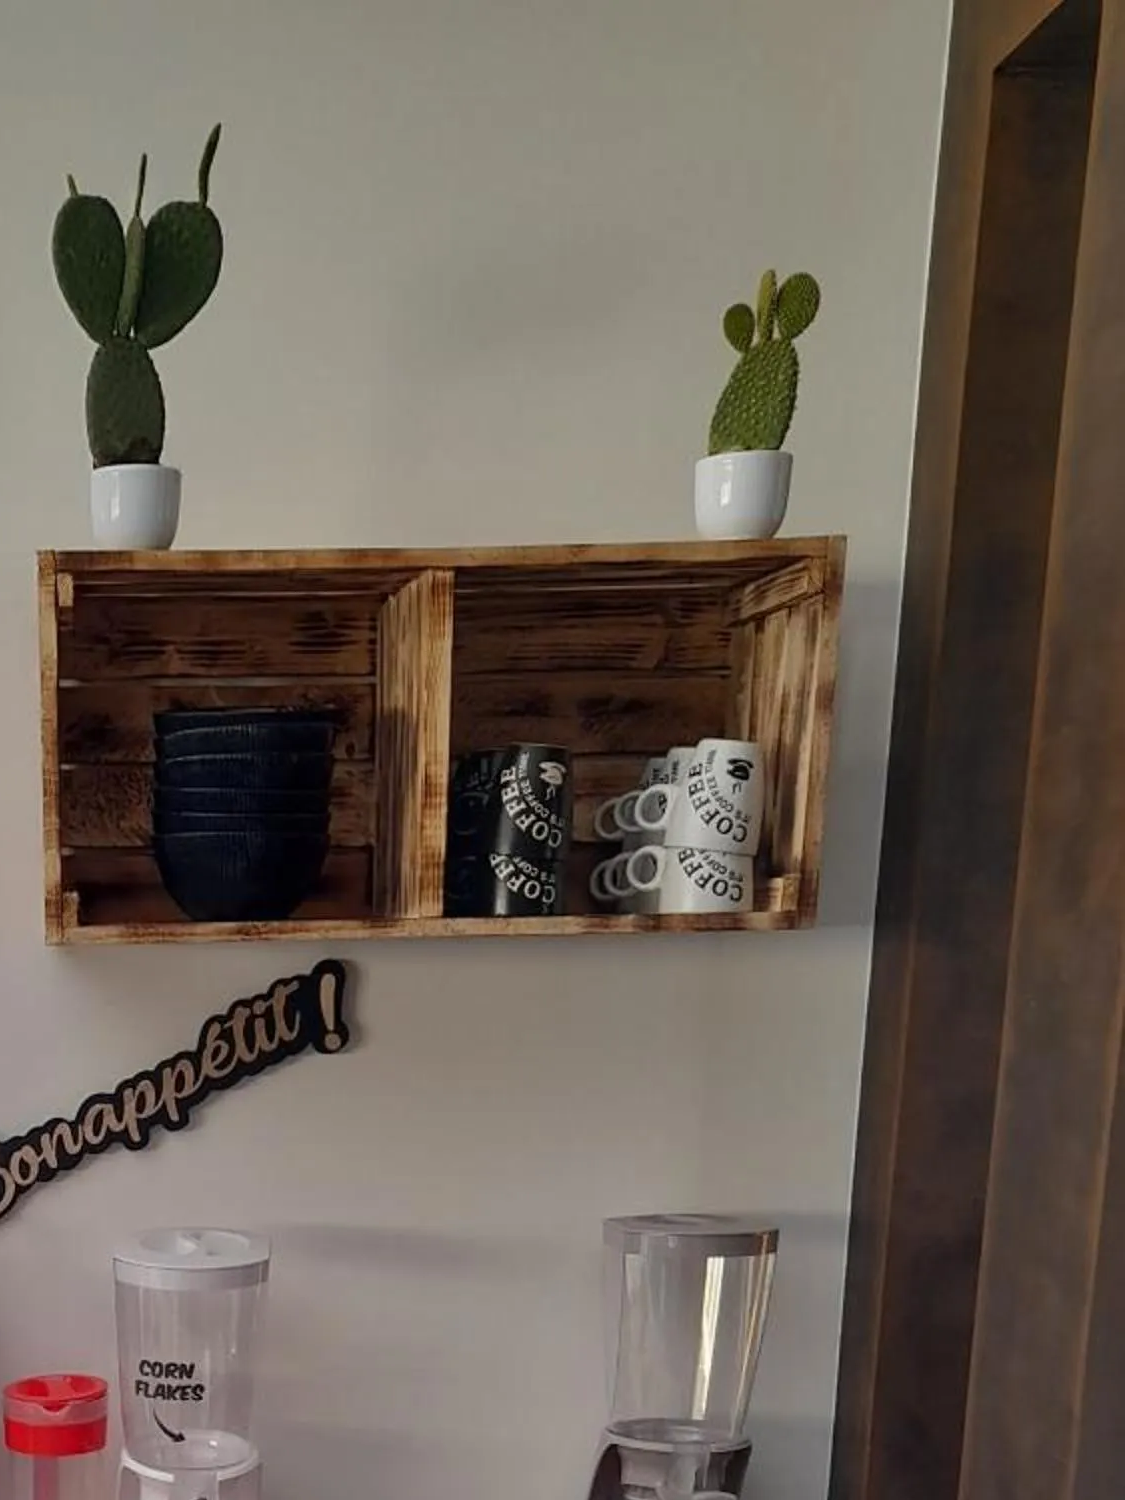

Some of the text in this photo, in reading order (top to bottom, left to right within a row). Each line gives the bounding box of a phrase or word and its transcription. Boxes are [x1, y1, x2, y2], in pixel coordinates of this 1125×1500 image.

[500, 765, 563, 848] COFFEE
[687, 762, 748, 844] COFFEE
[488, 852, 557, 904] COFF
[677, 847, 744, 903] COFFE
[134, 1379, 206, 1402] FLAKES
[138, 1359, 196, 1380] CORN
